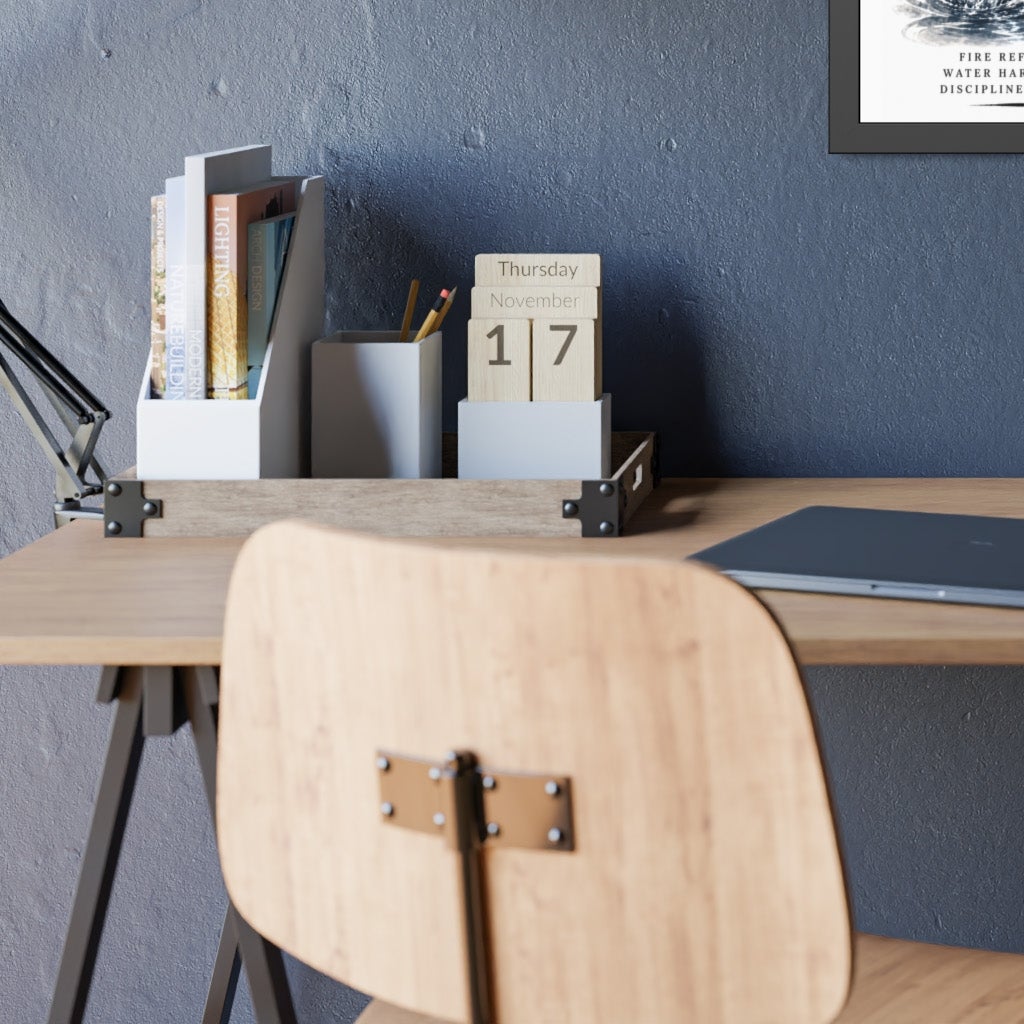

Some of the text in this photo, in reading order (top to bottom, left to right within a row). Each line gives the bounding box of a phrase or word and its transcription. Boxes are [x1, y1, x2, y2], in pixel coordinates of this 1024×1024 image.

[959, 52, 992, 62] FIRE
[943, 68, 992, 78] WATER
[940, 84, 1023, 94] DISCIPLINE
[214, 205, 230, 298] LIGHTING
[497, 260, 579, 281] Thursday
[251, 264, 264, 311] DESIGN
[490, 292, 581, 309] November
[188, 328, 203, 398] MODERN
